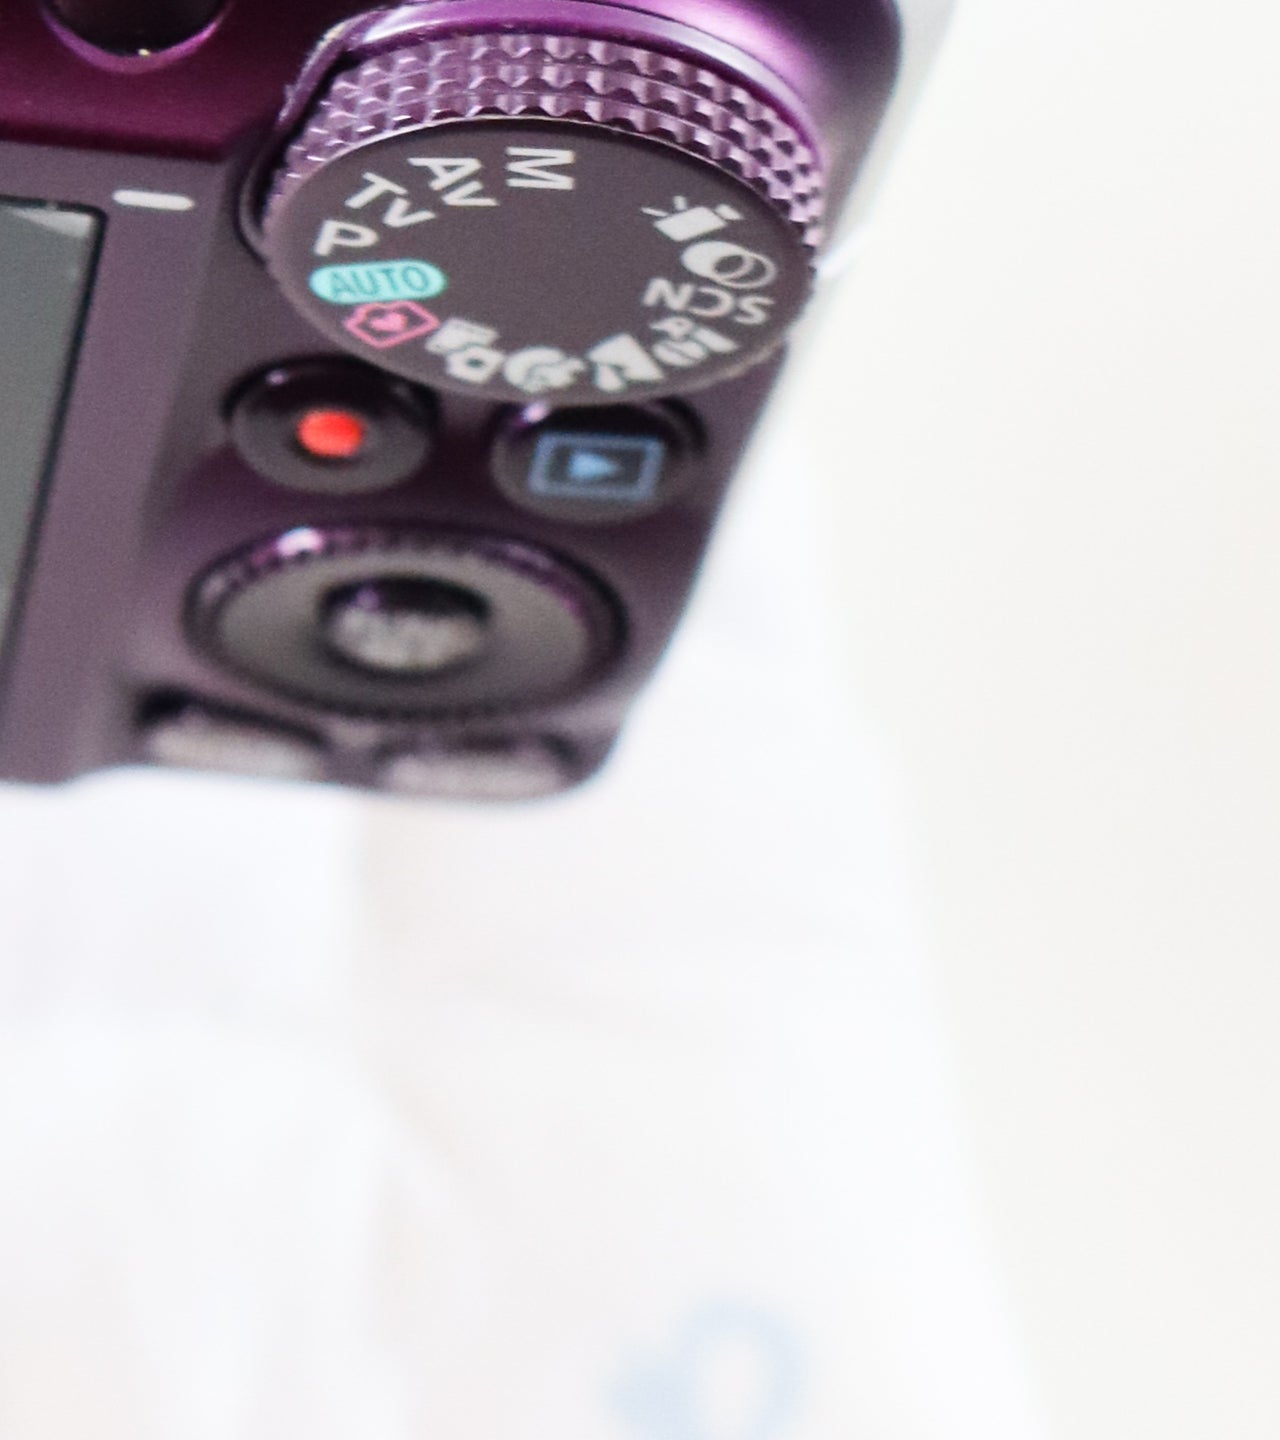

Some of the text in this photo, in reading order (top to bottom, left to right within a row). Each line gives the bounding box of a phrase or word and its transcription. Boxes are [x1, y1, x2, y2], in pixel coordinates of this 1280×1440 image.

[505, 146, 575, 191] M
[313, 219, 379, 257] P
[330, 265, 430, 298] AUTO
